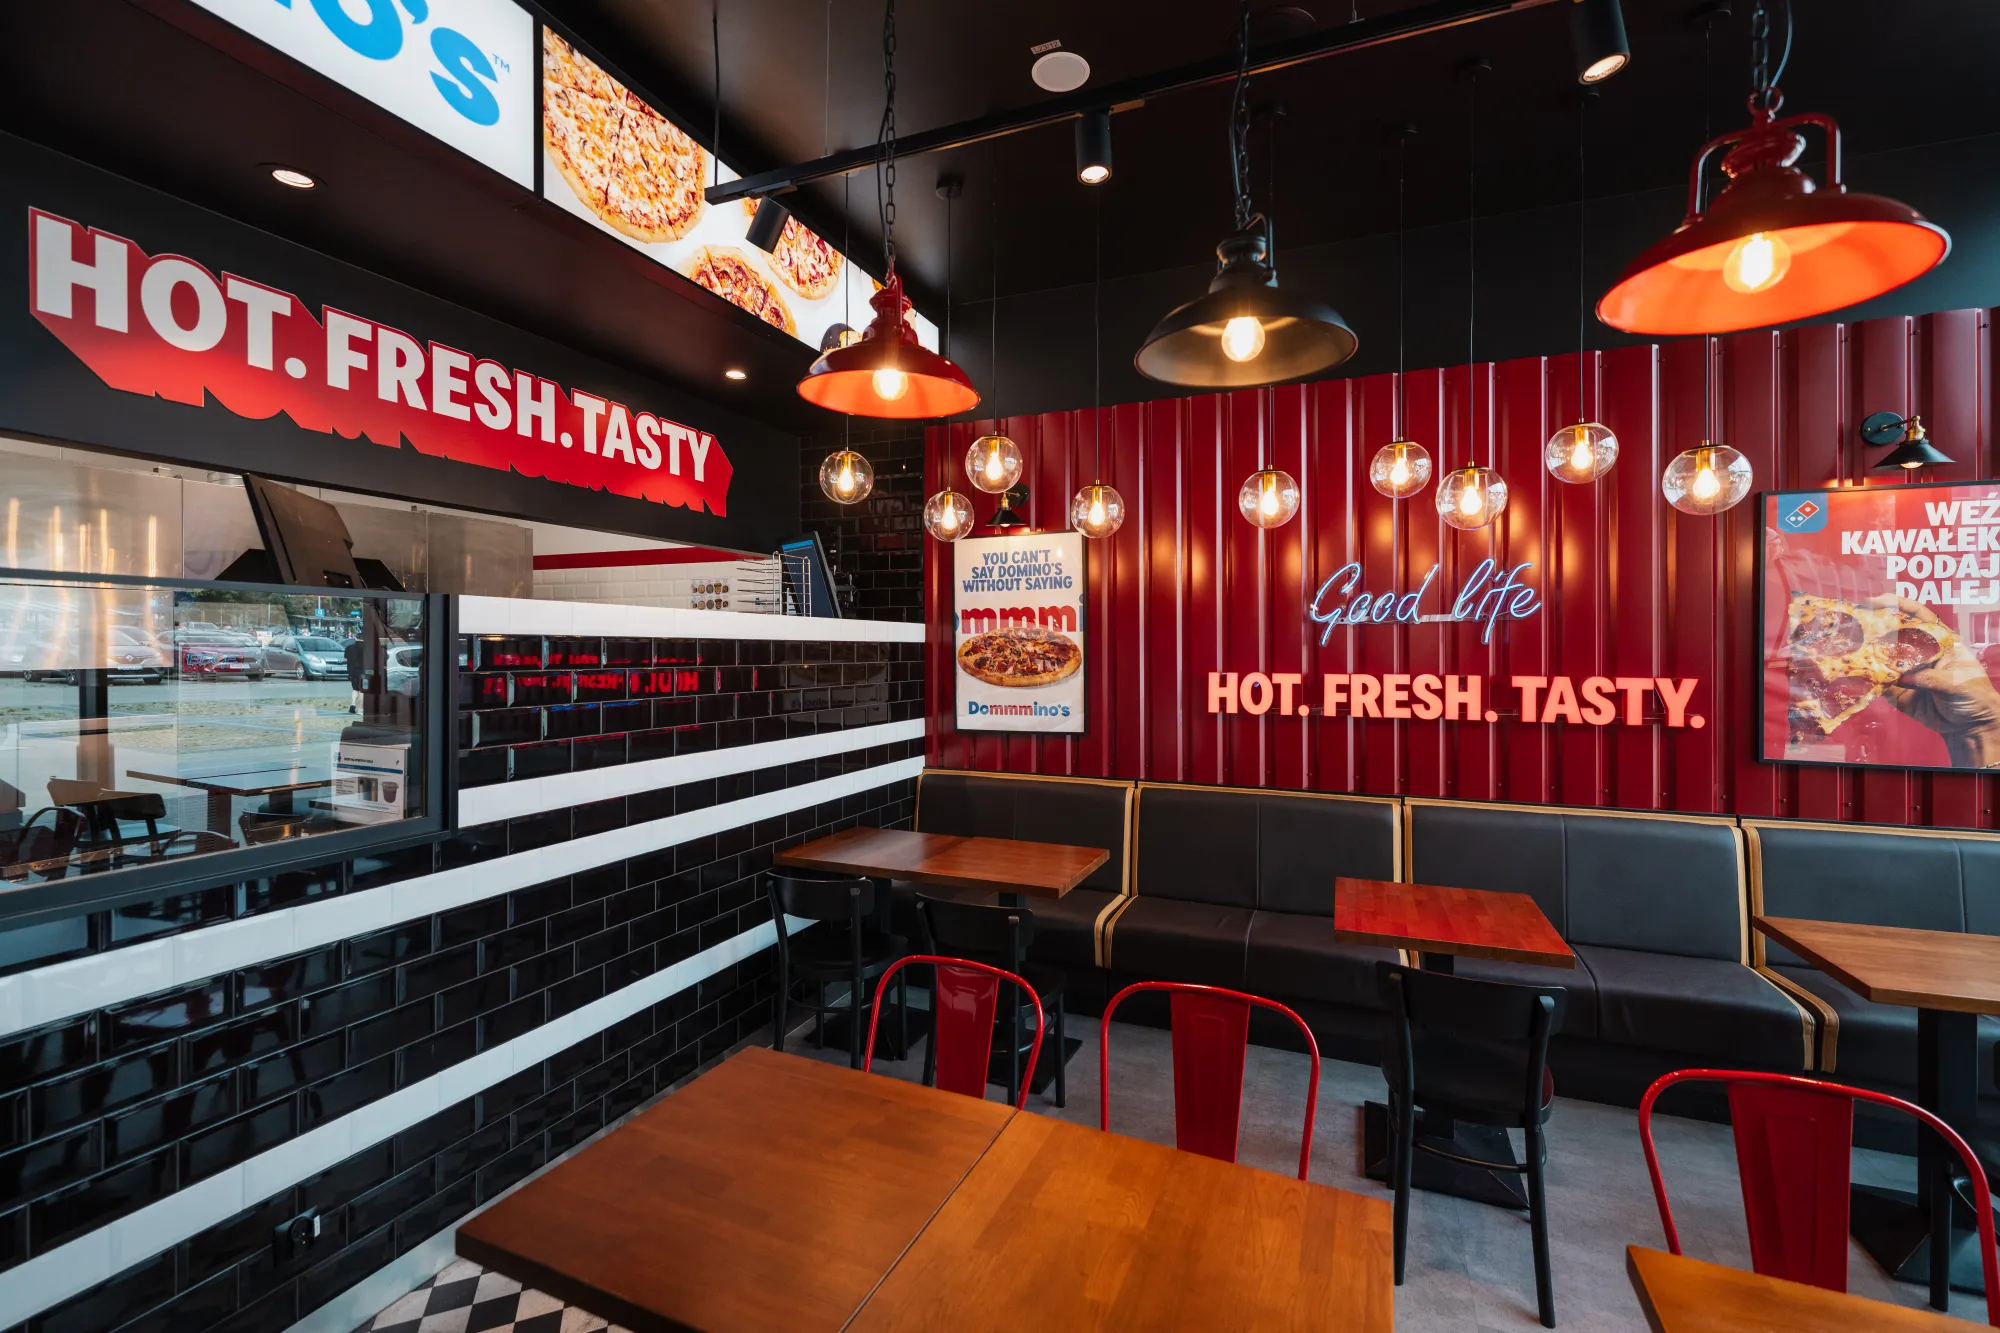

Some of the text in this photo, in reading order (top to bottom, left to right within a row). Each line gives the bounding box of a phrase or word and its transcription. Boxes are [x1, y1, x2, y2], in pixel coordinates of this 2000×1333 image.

[36, 214, 713, 483] HOT. FRESH. TASTY
[1924, 491, 2000, 526] WEŹ
[1841, 525, 2000, 556] KAWAŁEK
[971, 562, 1063, 580] SAY DOMINO'S
[982, 549, 1051, 565] YOU CAN'T
[1886, 553, 2000, 580] PODAJ
[962, 575, 1073, 593] WITHOUT SAYING
[1895, 579, 2000, 605] DALEJ
[954, 594, 1084, 635] mmm
[1310, 557, 1542, 646] Good life
[968, 701, 1071, 718] Dommmino's
[1207, 671, 1706, 729] HOT. FRESH. TASTY.
